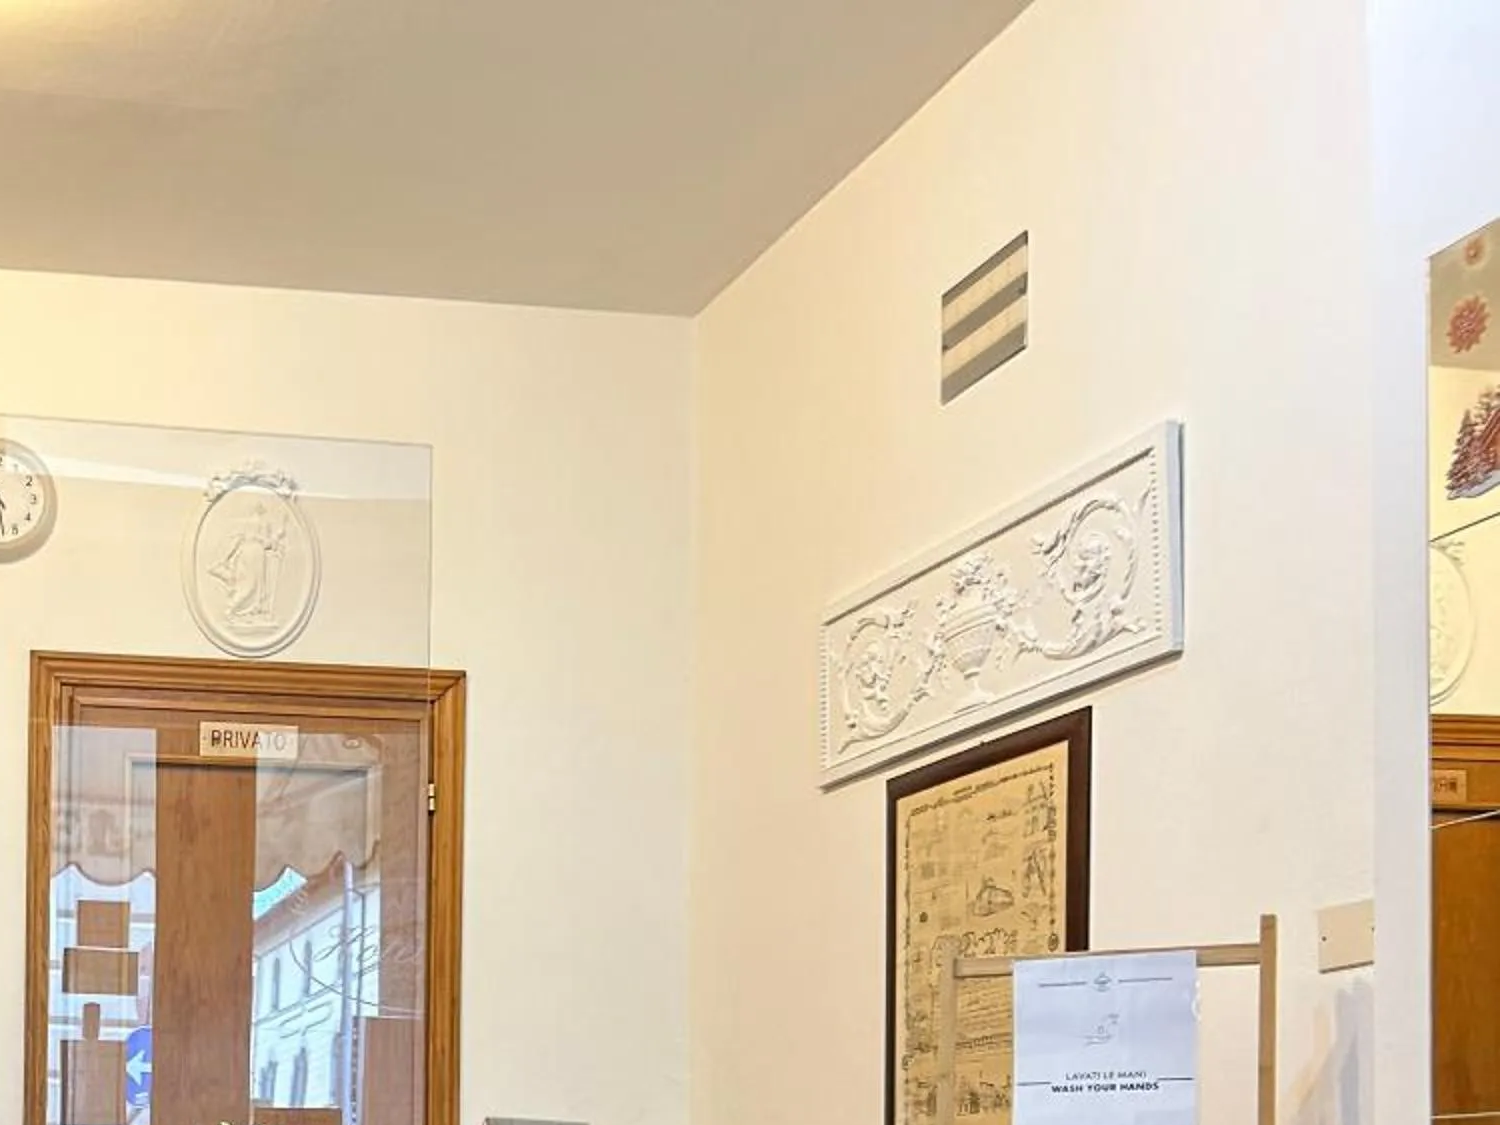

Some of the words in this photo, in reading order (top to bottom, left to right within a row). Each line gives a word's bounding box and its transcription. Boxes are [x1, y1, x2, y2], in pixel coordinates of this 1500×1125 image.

[25, 475, 33, 487] 2
[30, 493, 37, 505] 3
[24, 512, 31, 521] 4
[210, 729, 286, 751] PRIVATO
[1065, 1071, 1100, 1081] LAVATI
[1103, 1071, 1114, 1080] LE
[1117, 1070, 1147, 1079] MANI
[1051, 1084, 1083, 1093] WASH
[1087, 1083, 1116, 1092] YOUR
[1120, 1081, 1159, 1091] HANDS
